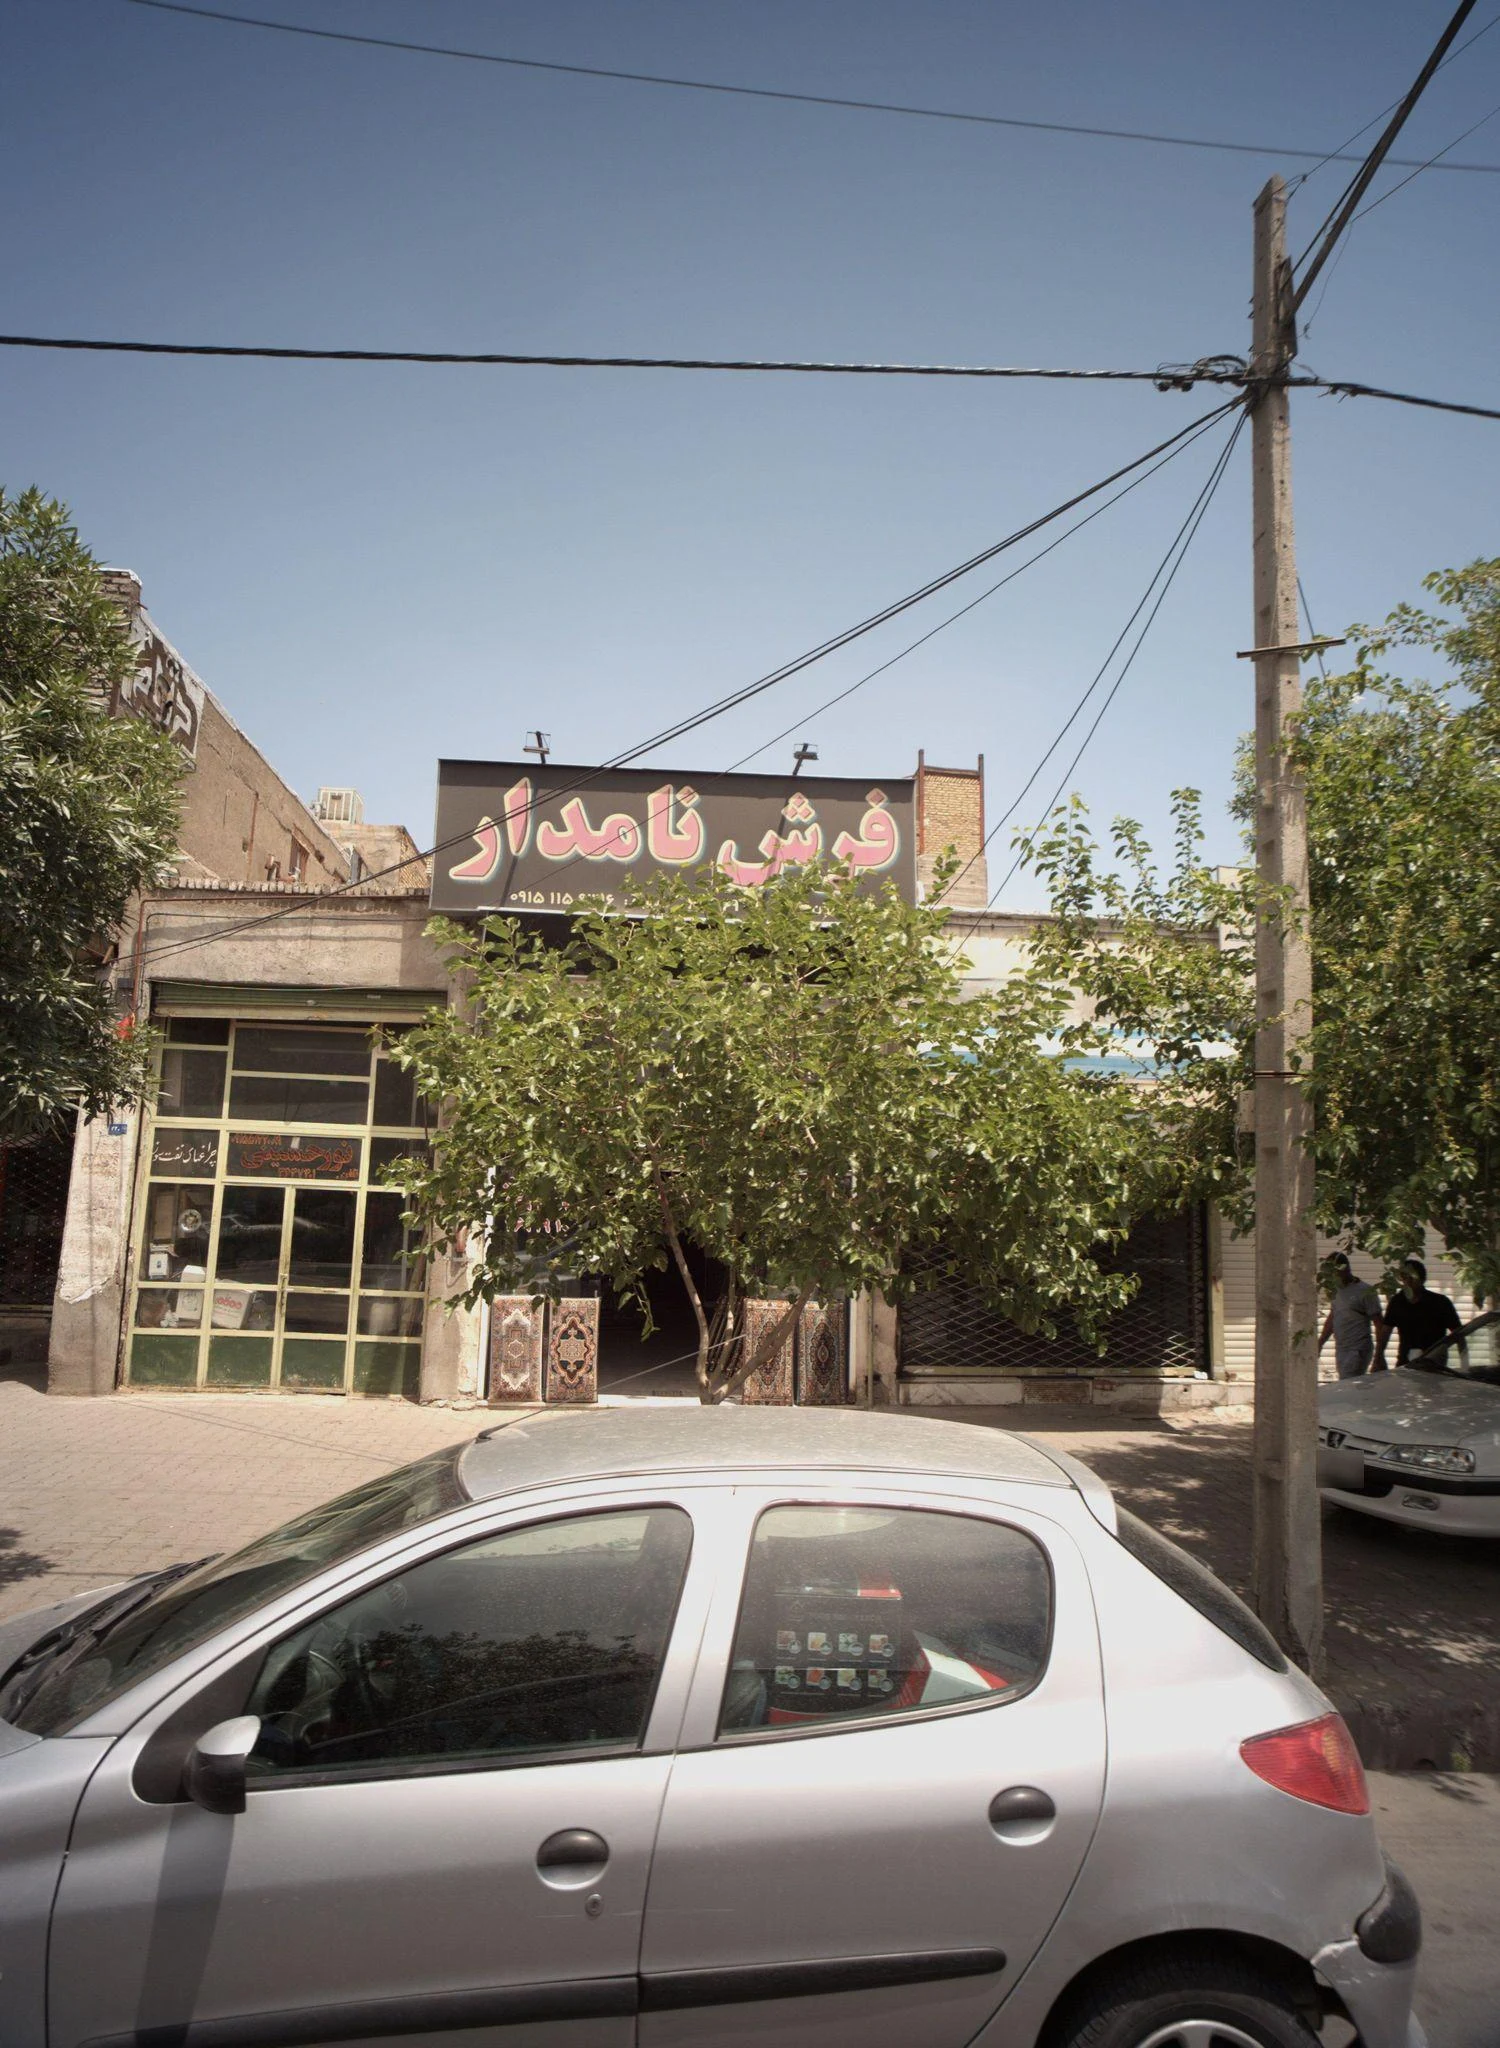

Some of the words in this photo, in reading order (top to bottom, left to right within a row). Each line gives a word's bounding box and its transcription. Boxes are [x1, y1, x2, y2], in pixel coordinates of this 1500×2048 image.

[448, 776, 707, 881] نامدار
[510, 890, 545, 904] ۰۹۱۵
[550, 891, 574, 905] ۱۱۵
